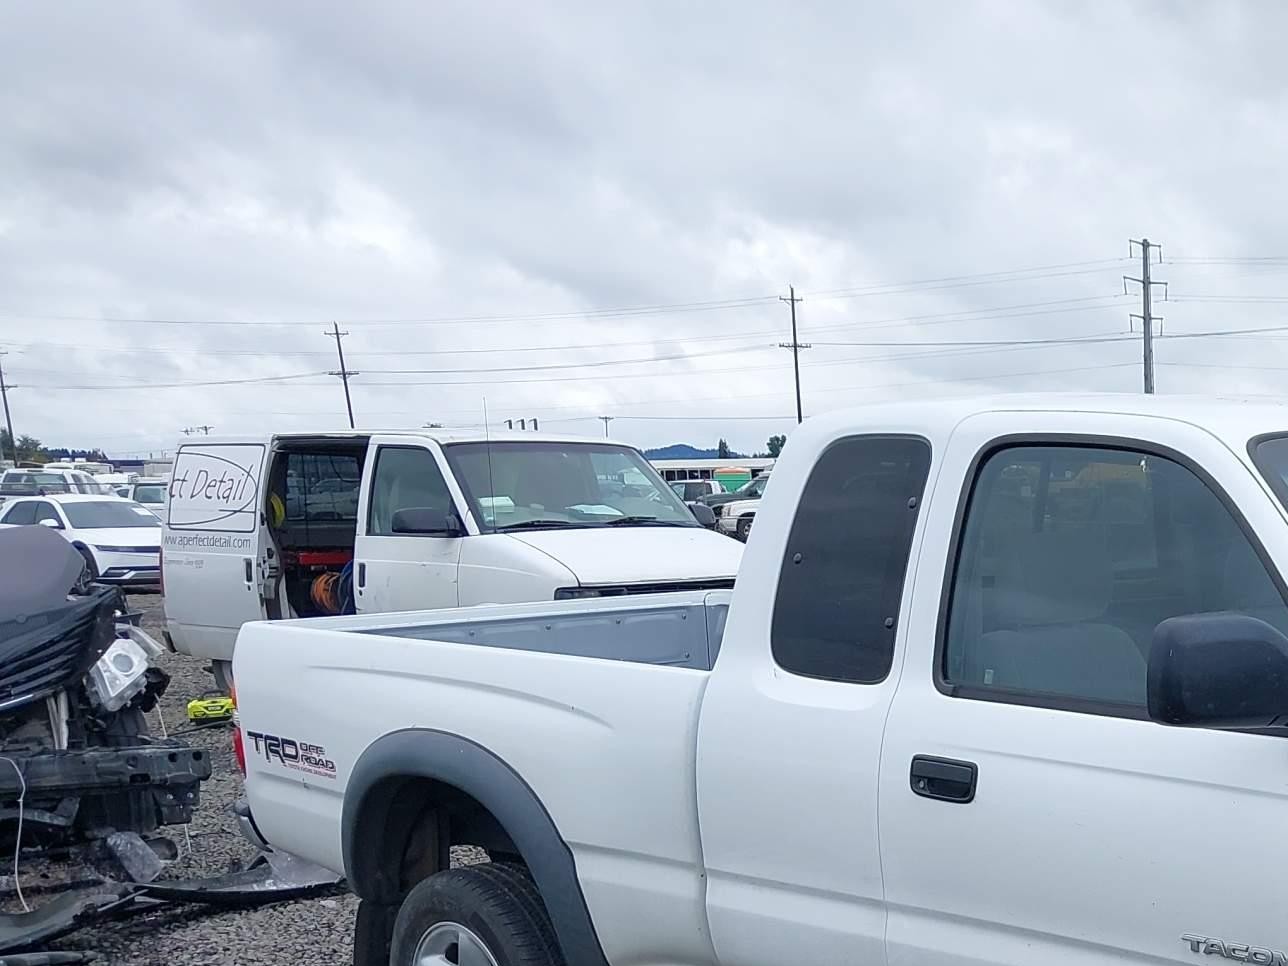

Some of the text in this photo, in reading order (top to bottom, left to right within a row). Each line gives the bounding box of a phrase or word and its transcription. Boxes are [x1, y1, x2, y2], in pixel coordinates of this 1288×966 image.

[190, 464, 254, 504] Detail
[247, 730, 300, 767] TRD
[301, 754, 337, 773] ROAD
